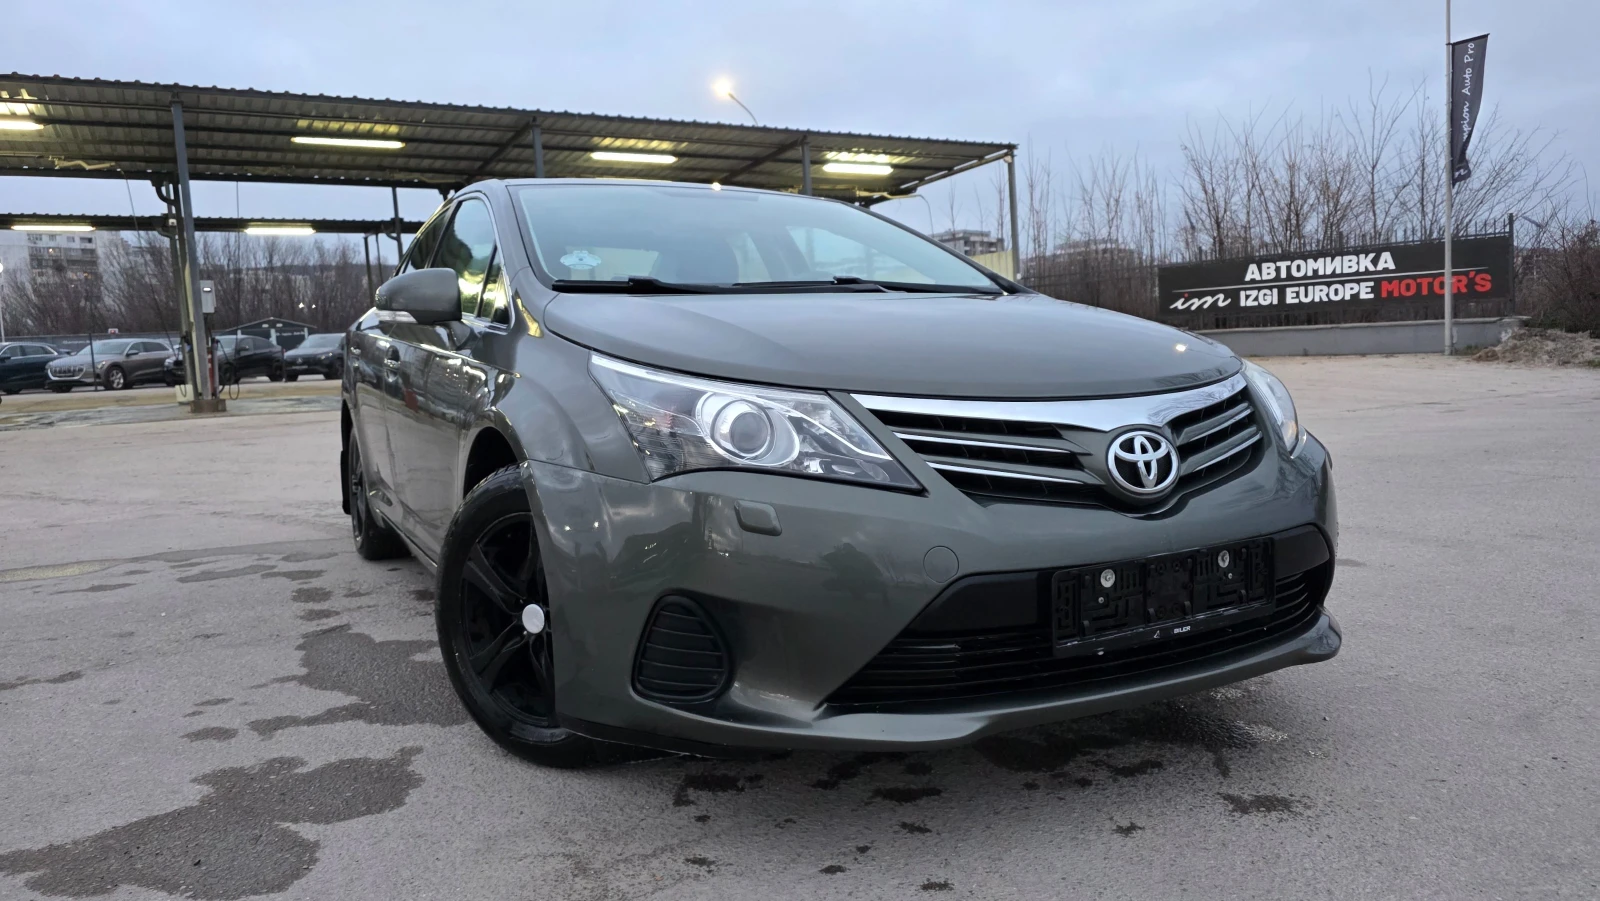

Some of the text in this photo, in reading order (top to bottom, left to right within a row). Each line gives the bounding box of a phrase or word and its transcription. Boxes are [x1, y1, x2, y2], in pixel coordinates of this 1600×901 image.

[1464, 42, 1475, 63] Pro
[1461, 67, 1473, 96] Auto
[1244, 251, 1396, 282] АВТОМИВКА
[1239, 290, 1279, 307] IZGI
[1285, 281, 1375, 305] EUROPE
[1380, 270, 1493, 298] MOTOR'S
